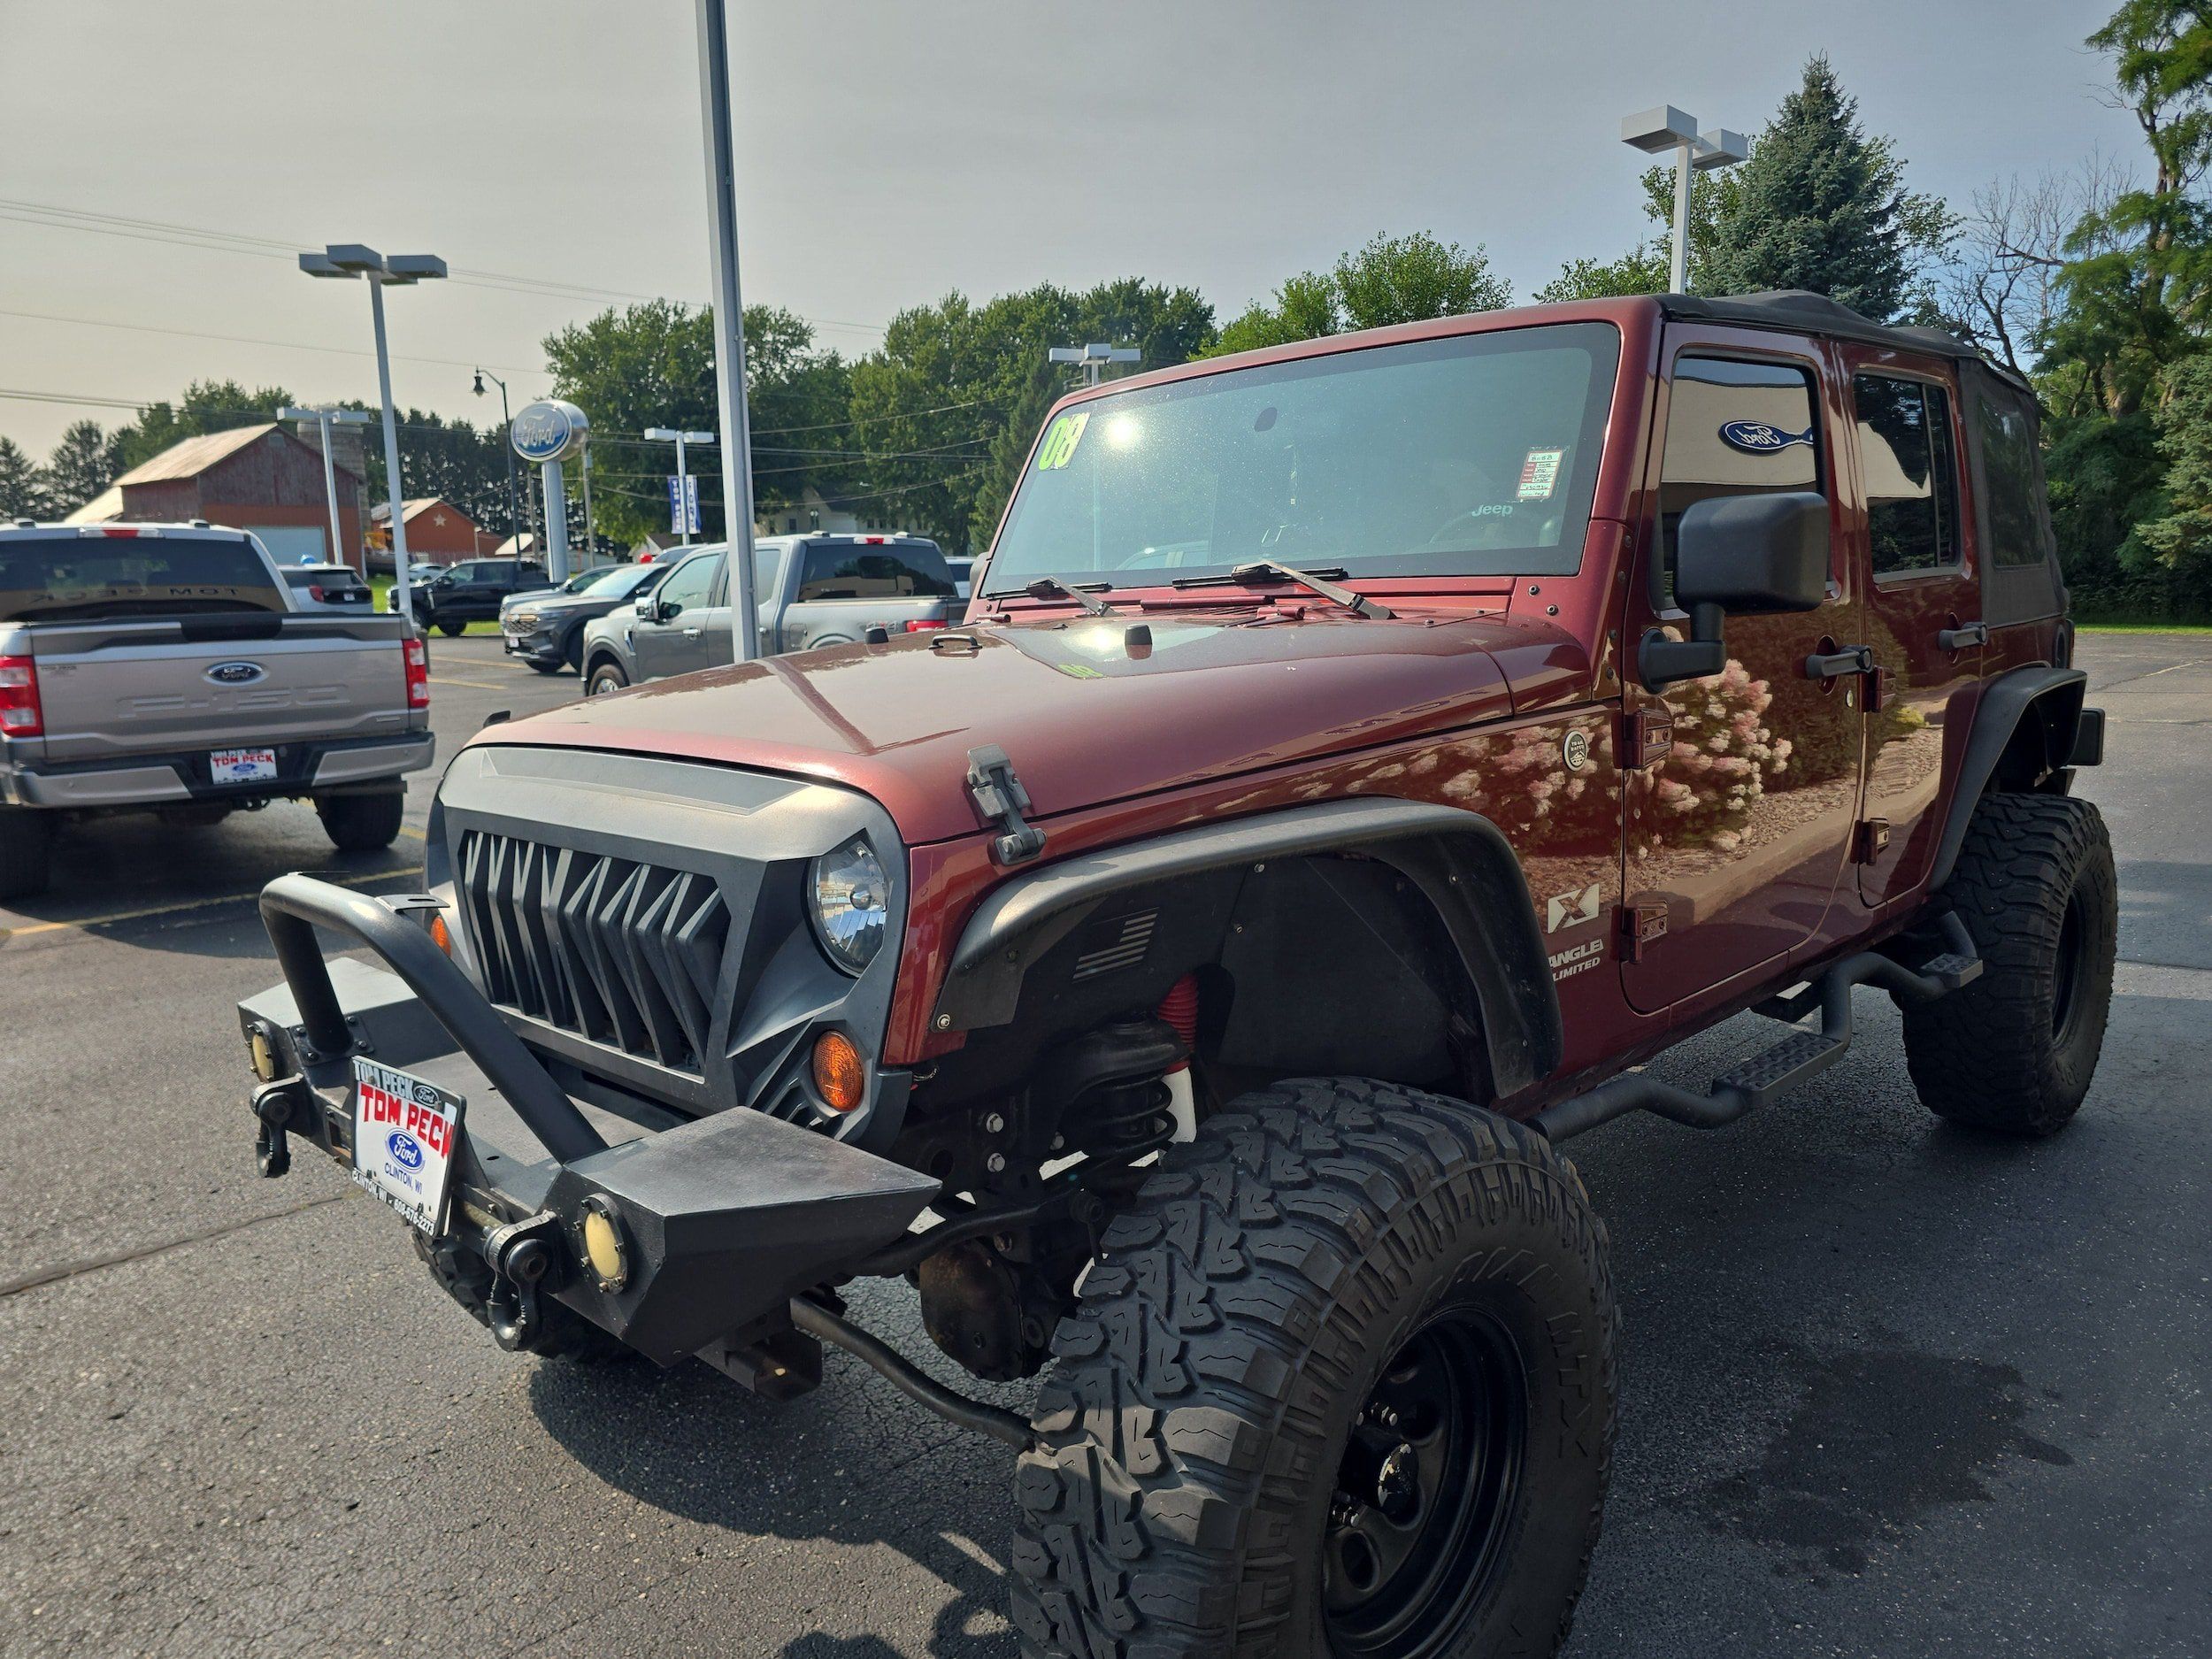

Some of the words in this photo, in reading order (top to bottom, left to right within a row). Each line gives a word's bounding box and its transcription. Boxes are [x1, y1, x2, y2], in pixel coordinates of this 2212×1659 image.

[523, 415, 556, 449] Ford
[1039, 412, 1088, 471] 08
[1471, 504, 1513, 517] Jeep
[213, 757, 239, 767] TOM
[242, 754, 273, 764] PECK
[353, 1060, 381, 1089] TOM
[381, 1070, 414, 1101] PECK
[360, 1083, 402, 1126] TOM
[394, 1135, 418, 1165] Ford
[385, 1163, 413, 1191] CLINTON,
[415, 1179, 422, 1194] WI
